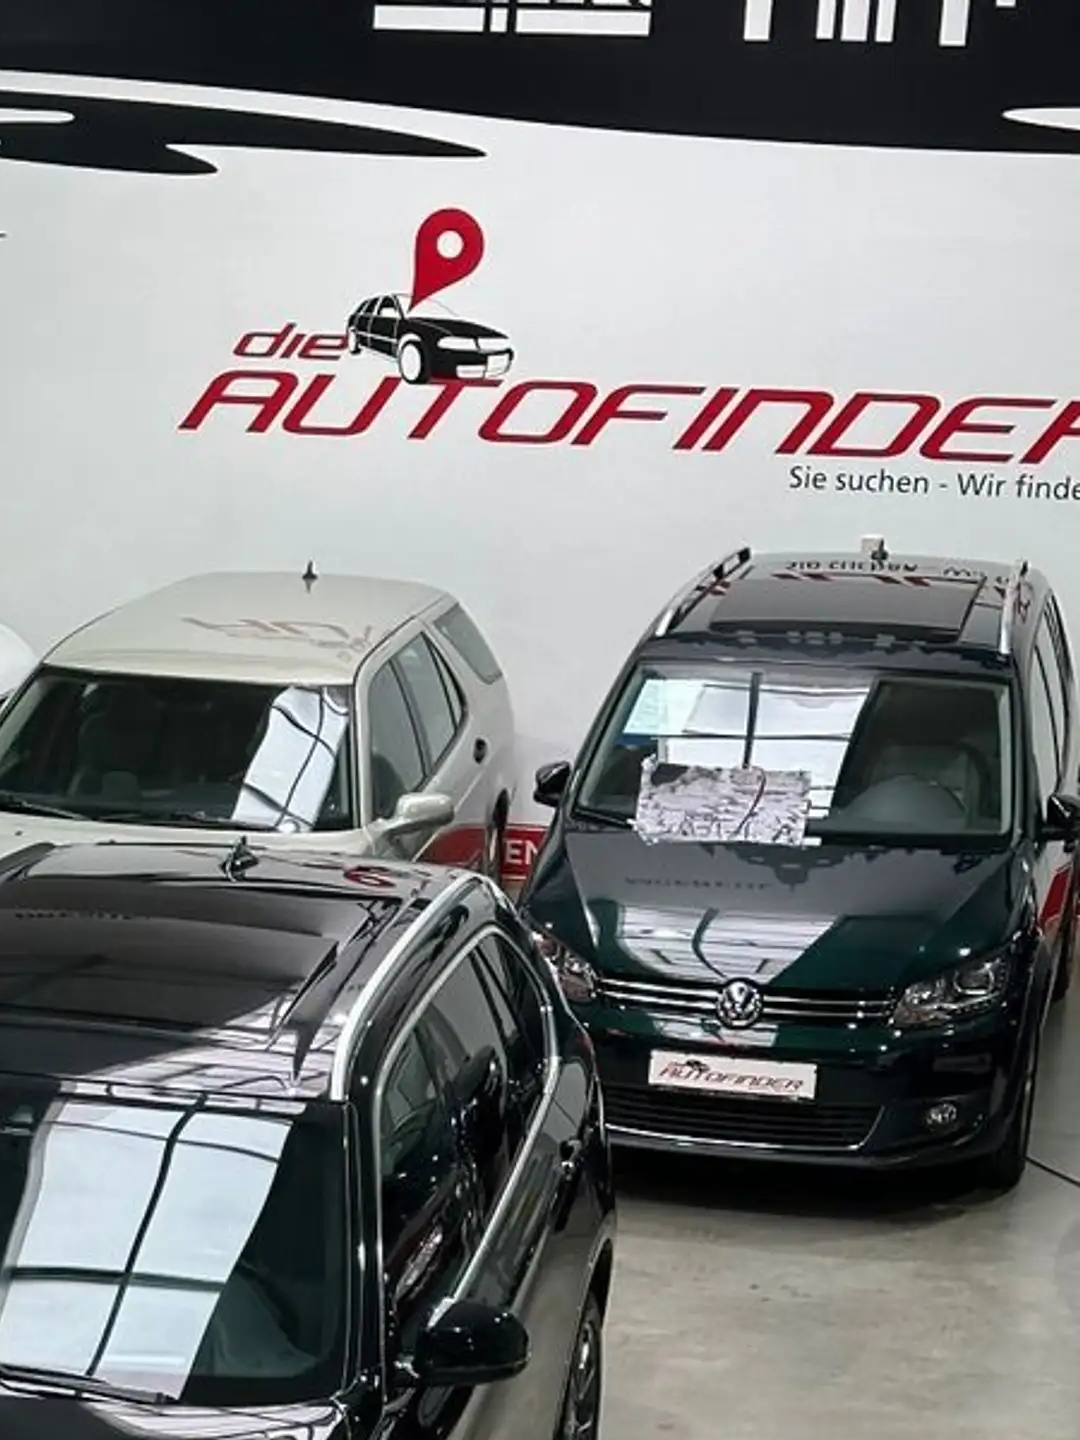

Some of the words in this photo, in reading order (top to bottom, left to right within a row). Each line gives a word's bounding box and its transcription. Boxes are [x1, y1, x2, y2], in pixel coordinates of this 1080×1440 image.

[232, 322, 351, 361] die
[789, 466, 827, 491] Sie
[836, 468, 928, 496] suchen
[957, 473, 1008, 497] Wir
